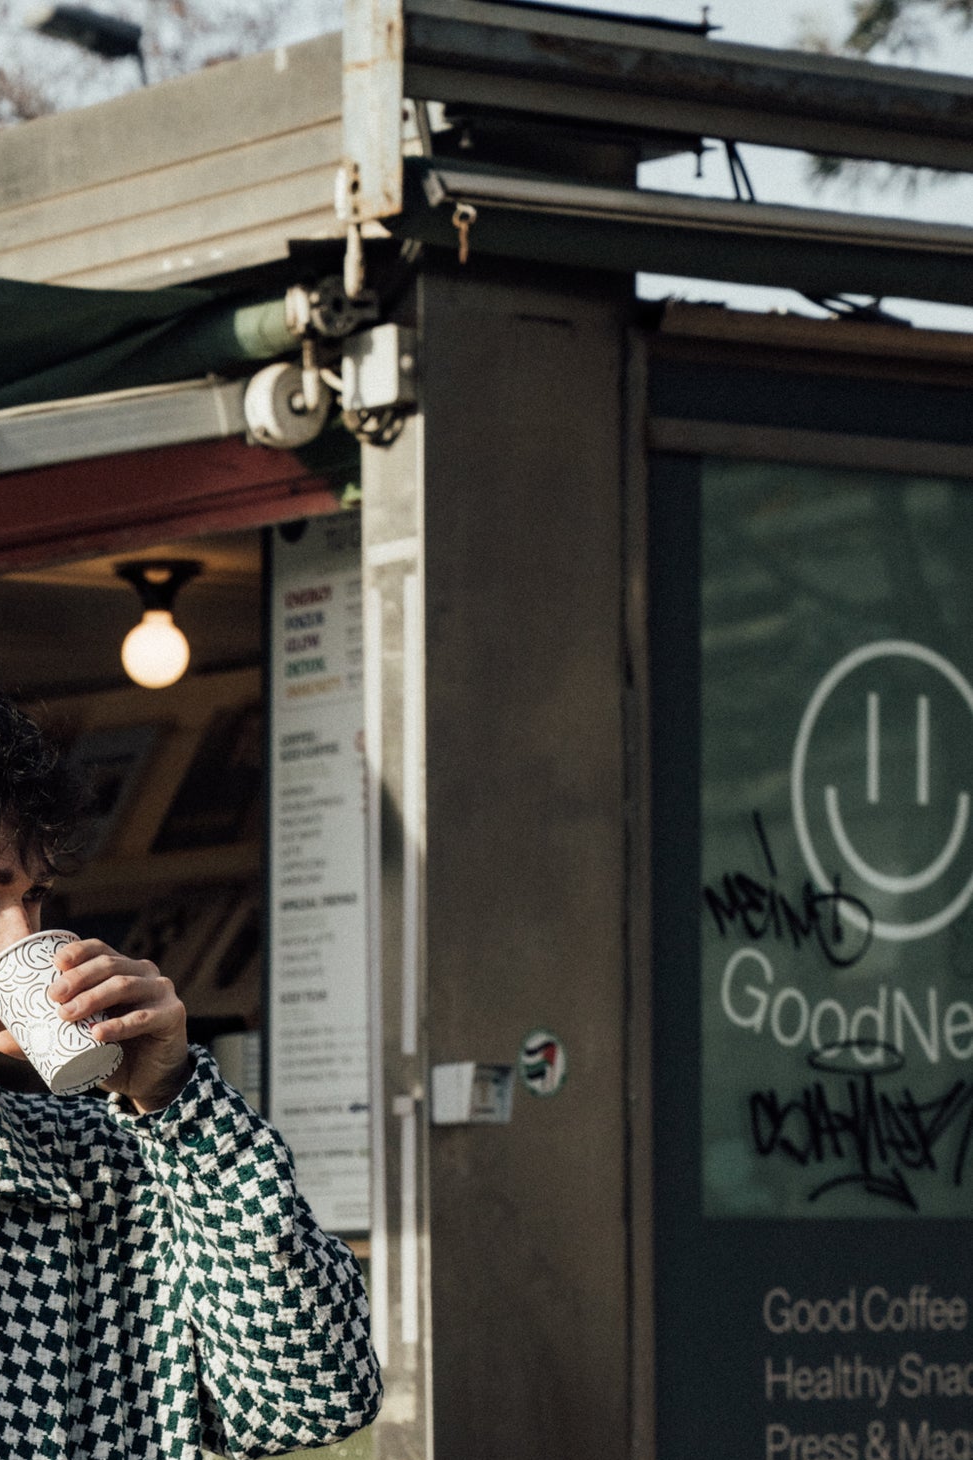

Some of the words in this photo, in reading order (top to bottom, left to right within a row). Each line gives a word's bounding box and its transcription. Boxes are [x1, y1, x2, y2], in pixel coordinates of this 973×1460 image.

[763, 1284, 857, 1334] Good
[862, 1284, 968, 1332] Coffee
[765, 1352, 896, 1409] Healthy
